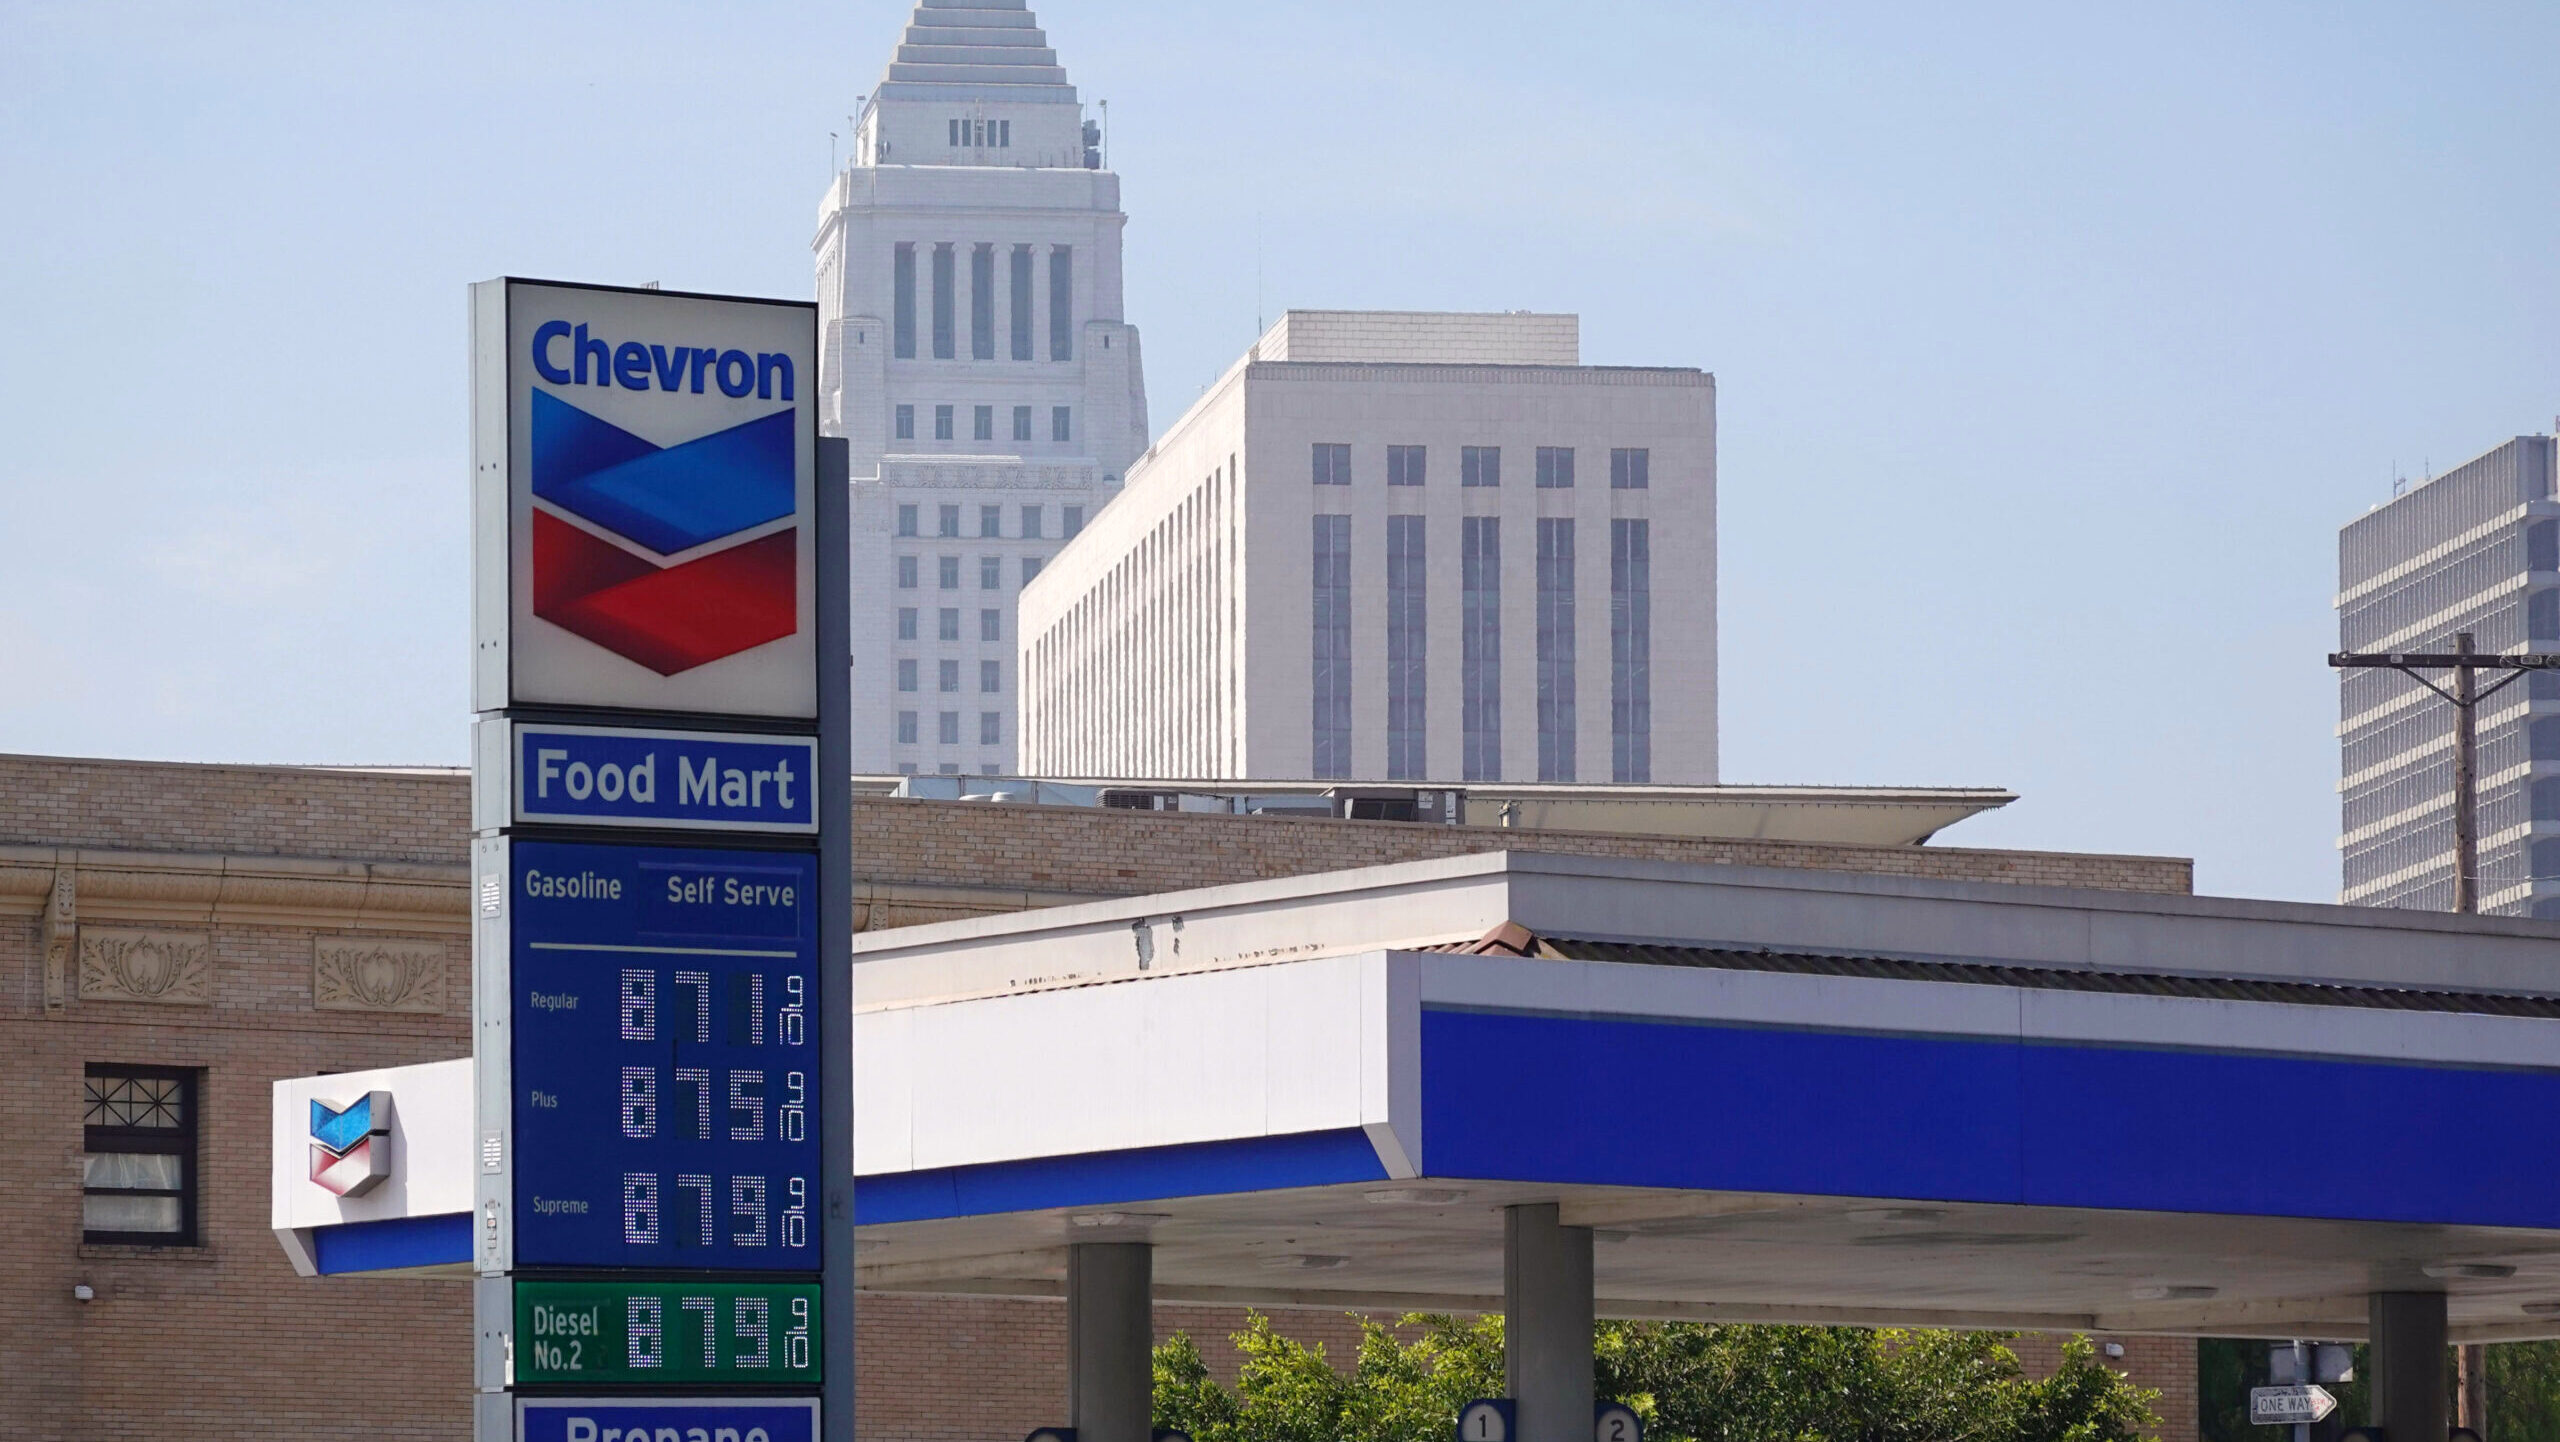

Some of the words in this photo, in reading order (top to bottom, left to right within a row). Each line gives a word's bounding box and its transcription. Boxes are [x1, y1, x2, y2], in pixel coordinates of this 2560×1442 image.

[532, 320, 795, 401] Chevron
[537, 749, 655, 803] Food
[679, 757, 795, 809] Mart
[526, 869, 622, 899] Gasoline
[667, 876, 715, 904] Self
[724, 878, 794, 906] Serve
[531, 991, 579, 1012] Regular
[531, 1091, 558, 1109] Plus
[533, 1196, 589, 1216] Supreme
[534, 1306, 598, 1335] Diesel
[535, 1340, 582, 1370] No.2
[2261, 1398, 2284, 1412] ONE
[2288, 1397, 2312, 1411] WAY
[1478, 1414, 1487, 1438] 1
[1610, 1419, 1625, 1442] 2
